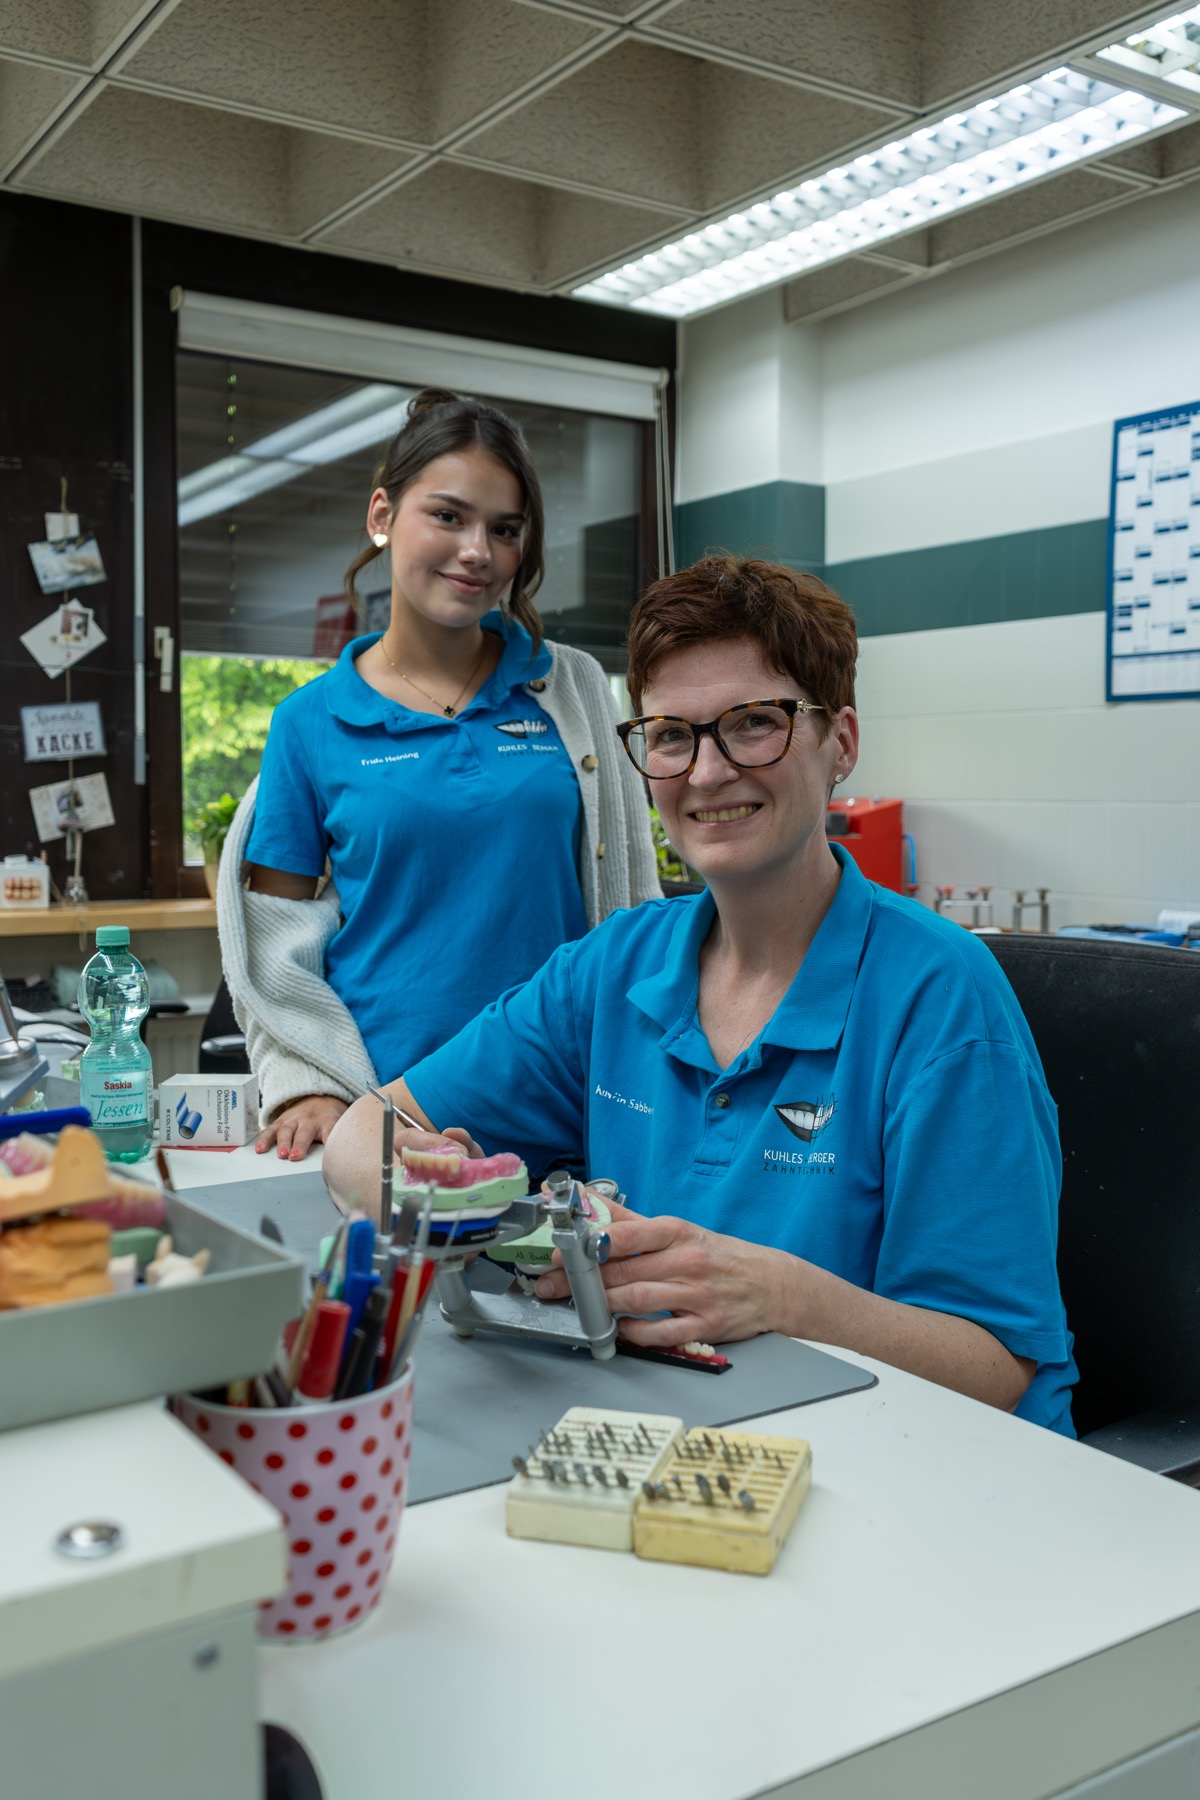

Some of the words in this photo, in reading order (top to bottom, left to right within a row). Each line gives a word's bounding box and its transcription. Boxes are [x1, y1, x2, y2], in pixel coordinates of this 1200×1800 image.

[36, 731, 94, 752] KACKE
[104, 1081, 132, 1090] Saskia
[93, 1100, 143, 1121] Jessen
[763, 1149, 804, 1164] KUHLES
[763, 1161, 835, 1176] ZAHNTECHNIK
